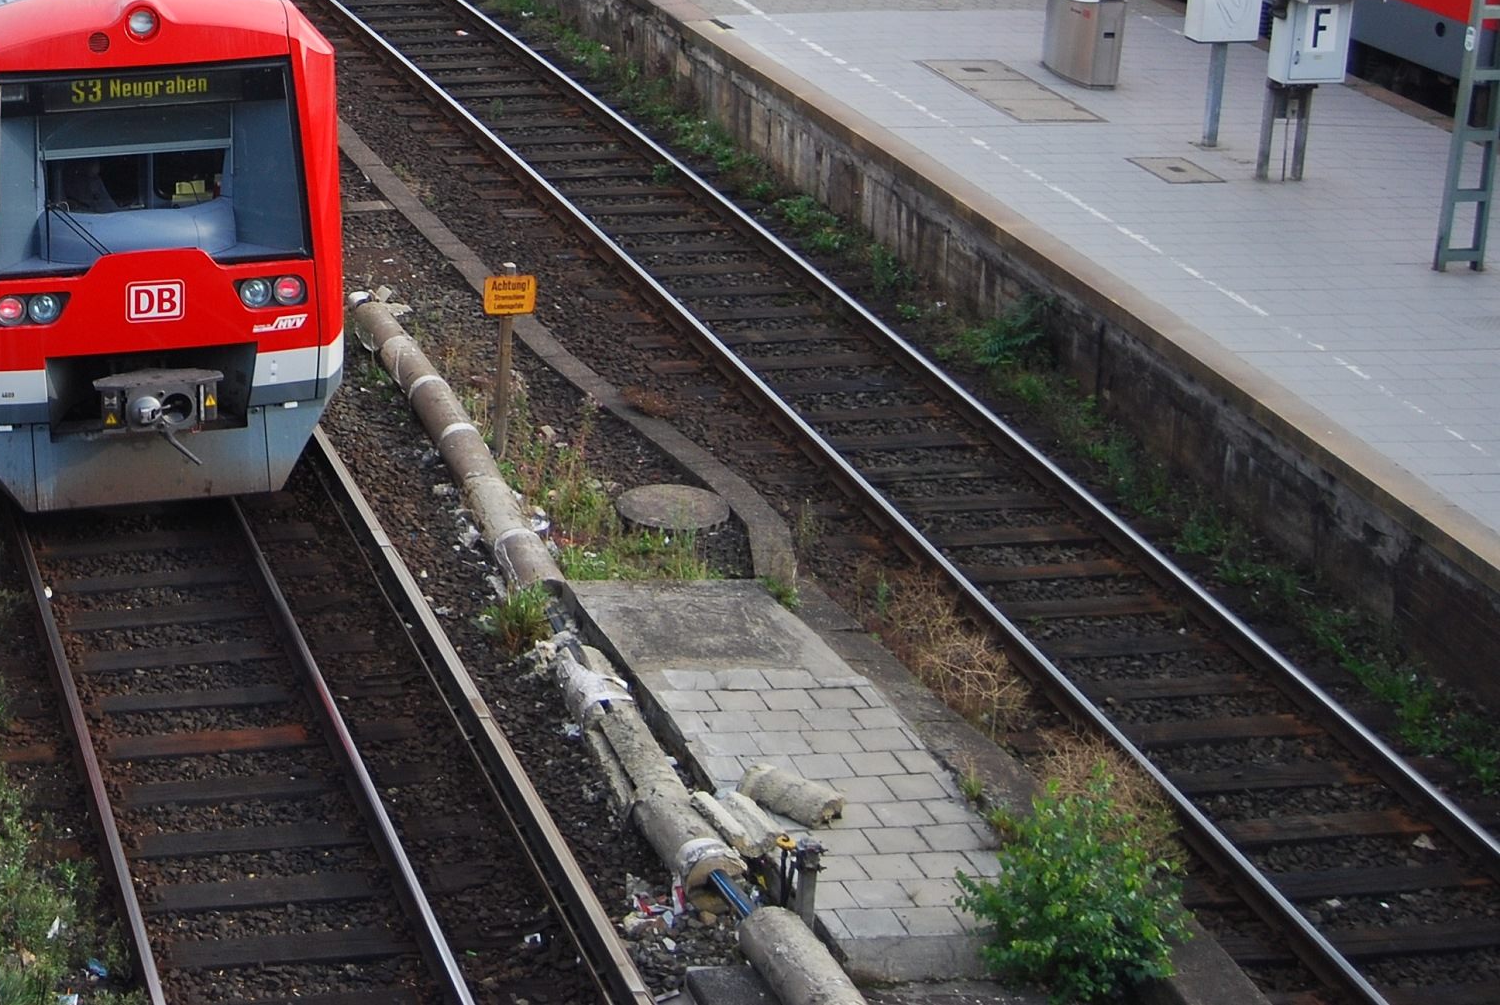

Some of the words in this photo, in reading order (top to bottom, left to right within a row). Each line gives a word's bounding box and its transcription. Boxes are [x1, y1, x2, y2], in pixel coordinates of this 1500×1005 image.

[1312, 8, 1331, 48] F
[72, 79, 102, 103] S3
[110, 76, 208, 99] Neugraben
[492, 279, 531, 292] Achtung!
[134, 287, 177, 315] DB
